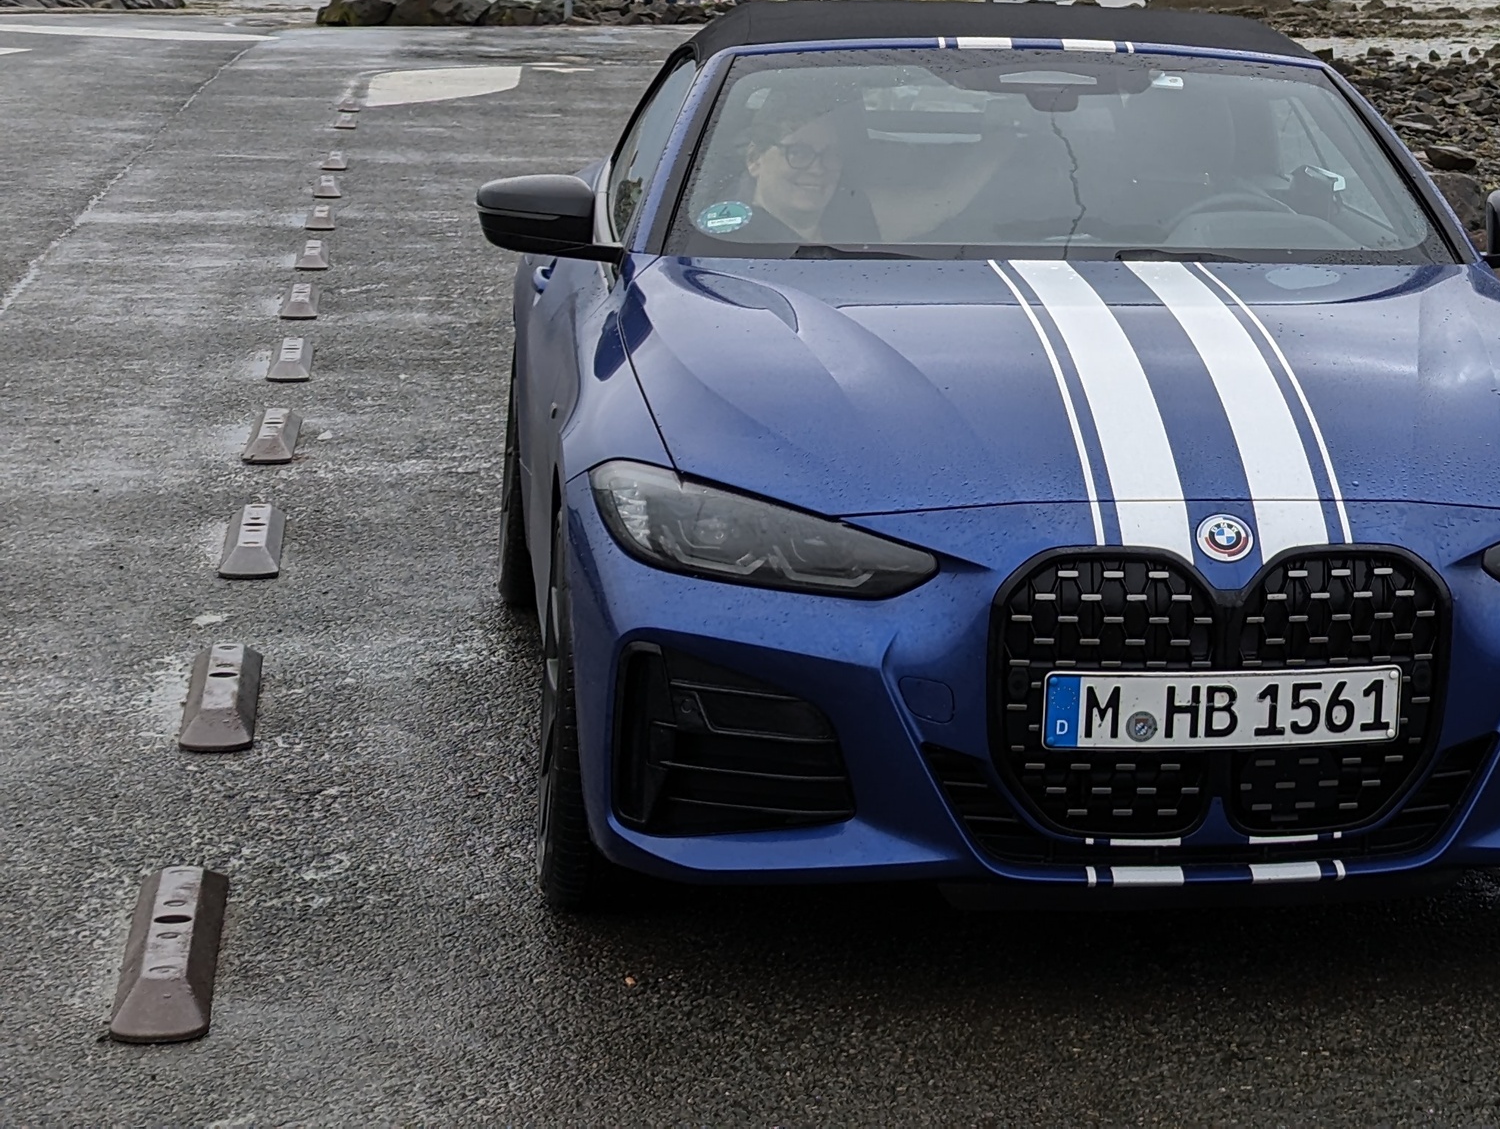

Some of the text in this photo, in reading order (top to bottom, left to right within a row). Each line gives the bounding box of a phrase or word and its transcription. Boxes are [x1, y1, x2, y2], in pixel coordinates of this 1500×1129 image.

[1210, 521, 1239, 533] BMW
[1084, 686, 1121, 738] M
[1164, 685, 1238, 738] HB
[1254, 679, 1390, 737] 1561
[1056, 720, 1069, 735] D
